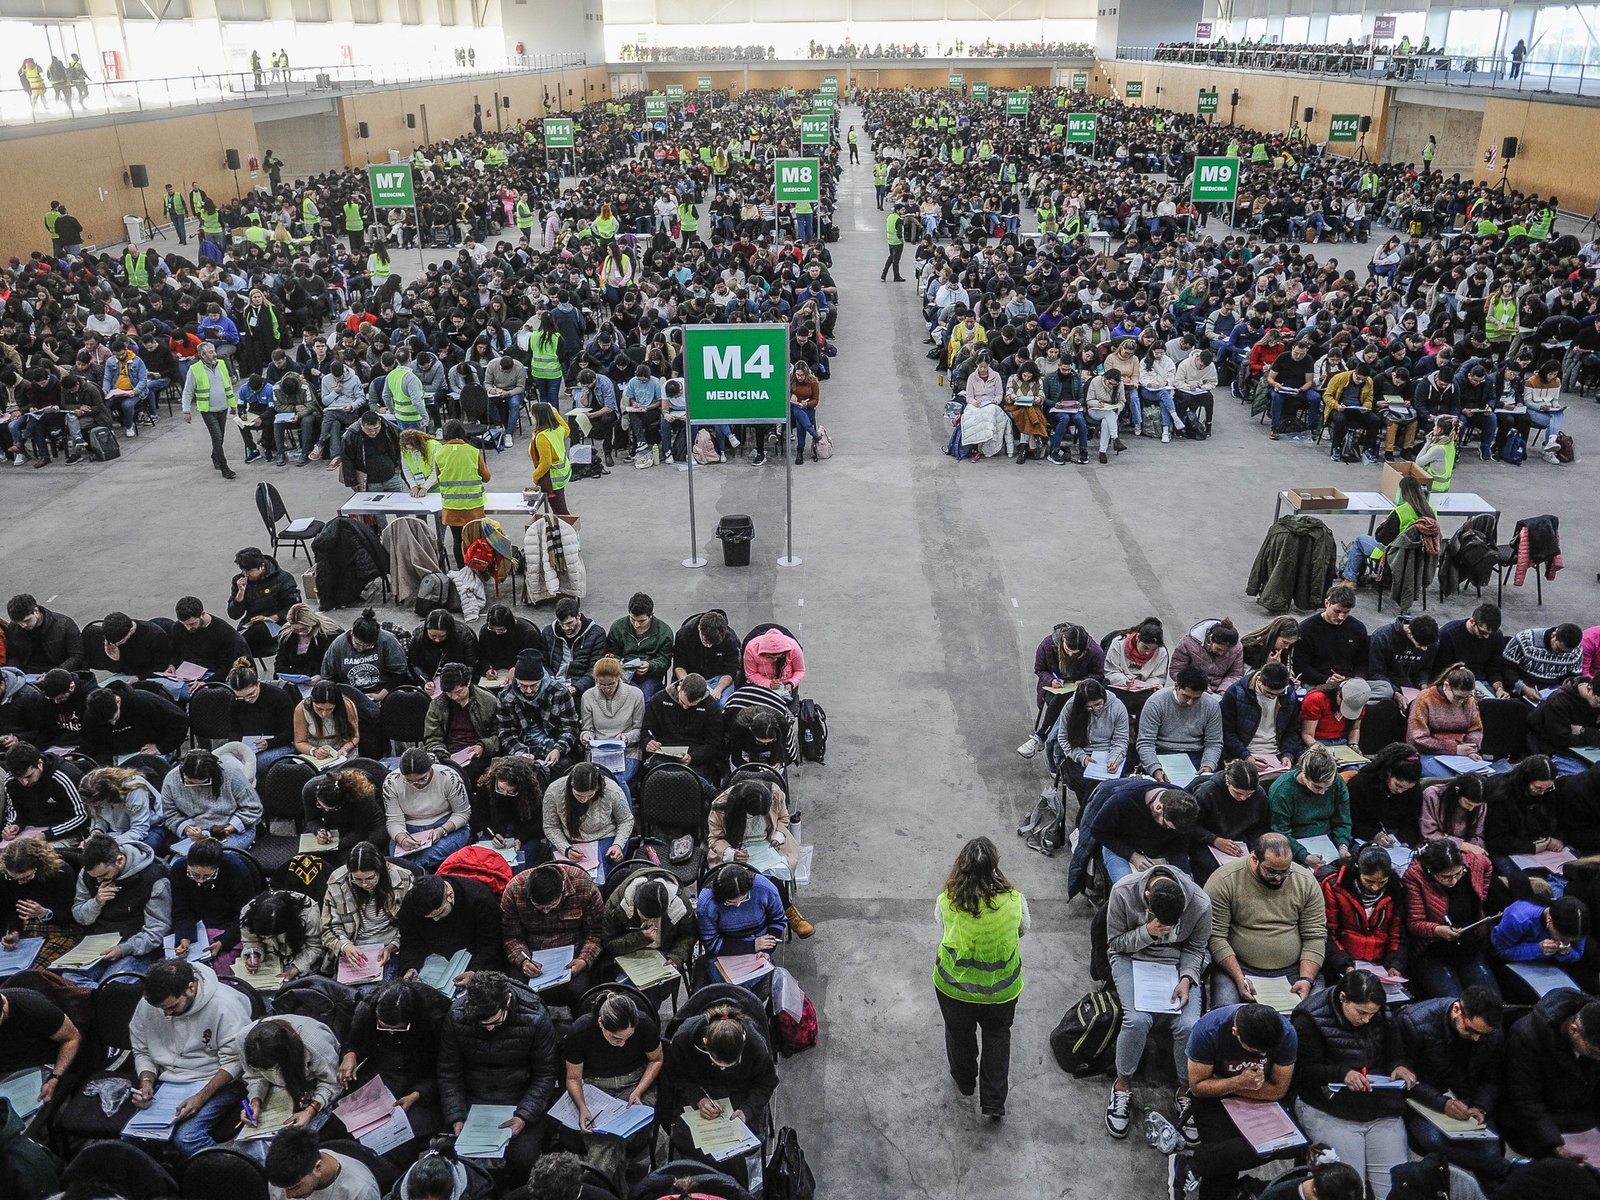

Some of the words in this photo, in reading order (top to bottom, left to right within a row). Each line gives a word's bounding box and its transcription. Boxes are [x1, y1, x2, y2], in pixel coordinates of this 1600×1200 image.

[647, 101, 666, 109] M15
[814, 99, 833, 107] M16
[1008, 97, 1027, 105] M17
[1199, 97, 1218, 105] M18
[546, 125, 570, 135] M11
[802, 121, 828, 132] M12
[1069, 120, 1095, 130] M13
[1331, 120, 1358, 130] M14
[782, 166, 812, 183] M8
[1200, 165, 1232, 182] M9
[375, 172, 405, 189] M7
[702, 344, 774, 380] M4
[706, 390, 769, 400] MEDICINA
[344, 653, 379, 665] RAMONES
